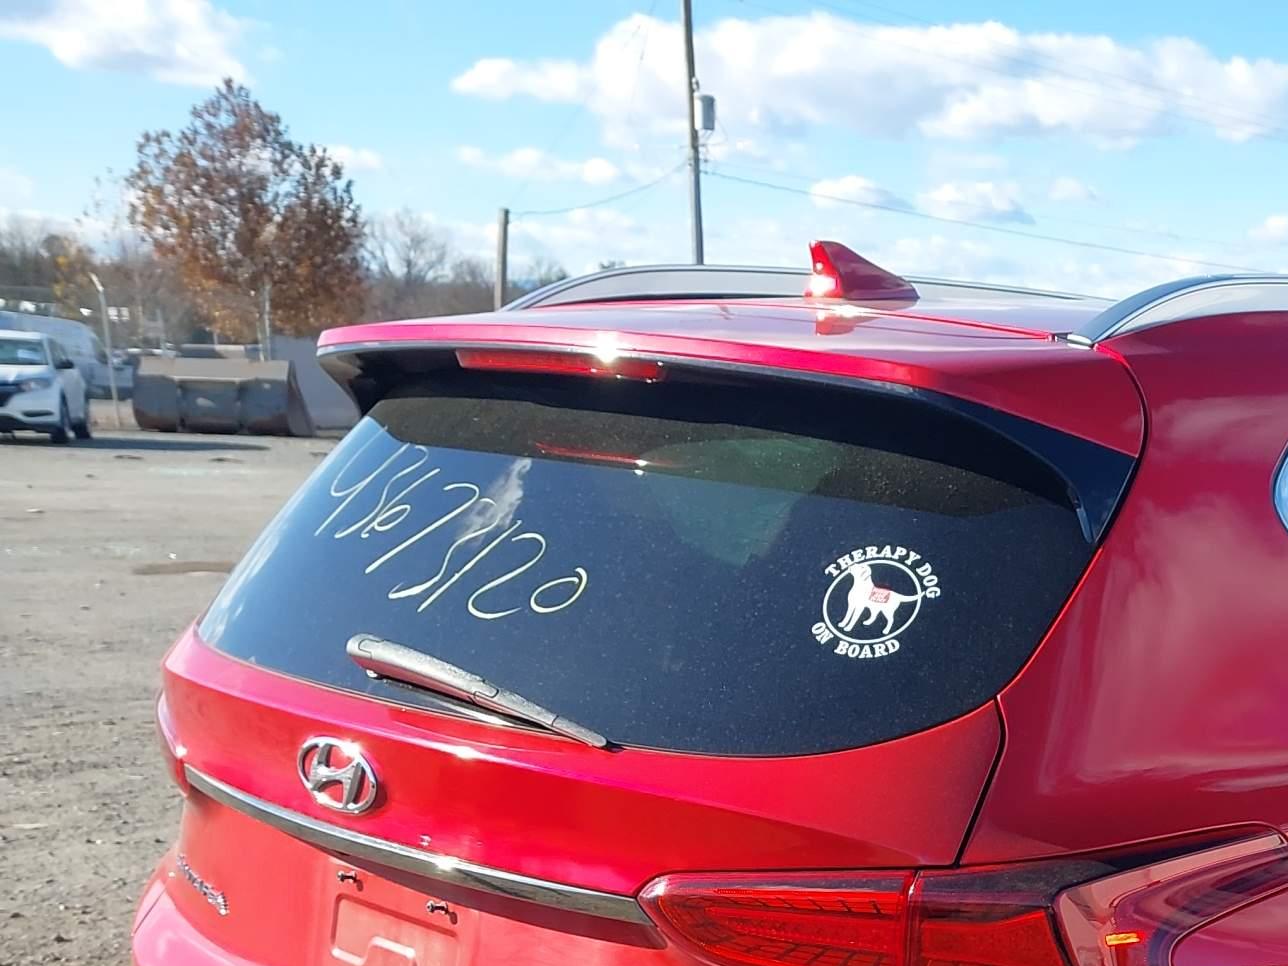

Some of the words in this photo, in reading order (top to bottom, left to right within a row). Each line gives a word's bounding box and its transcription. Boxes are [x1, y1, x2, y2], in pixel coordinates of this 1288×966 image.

[824, 545, 922, 578] THERAPY
[915, 562, 941, 599] DOG
[811, 622, 835, 645] ON
[834, 639, 900, 659] BOARD
